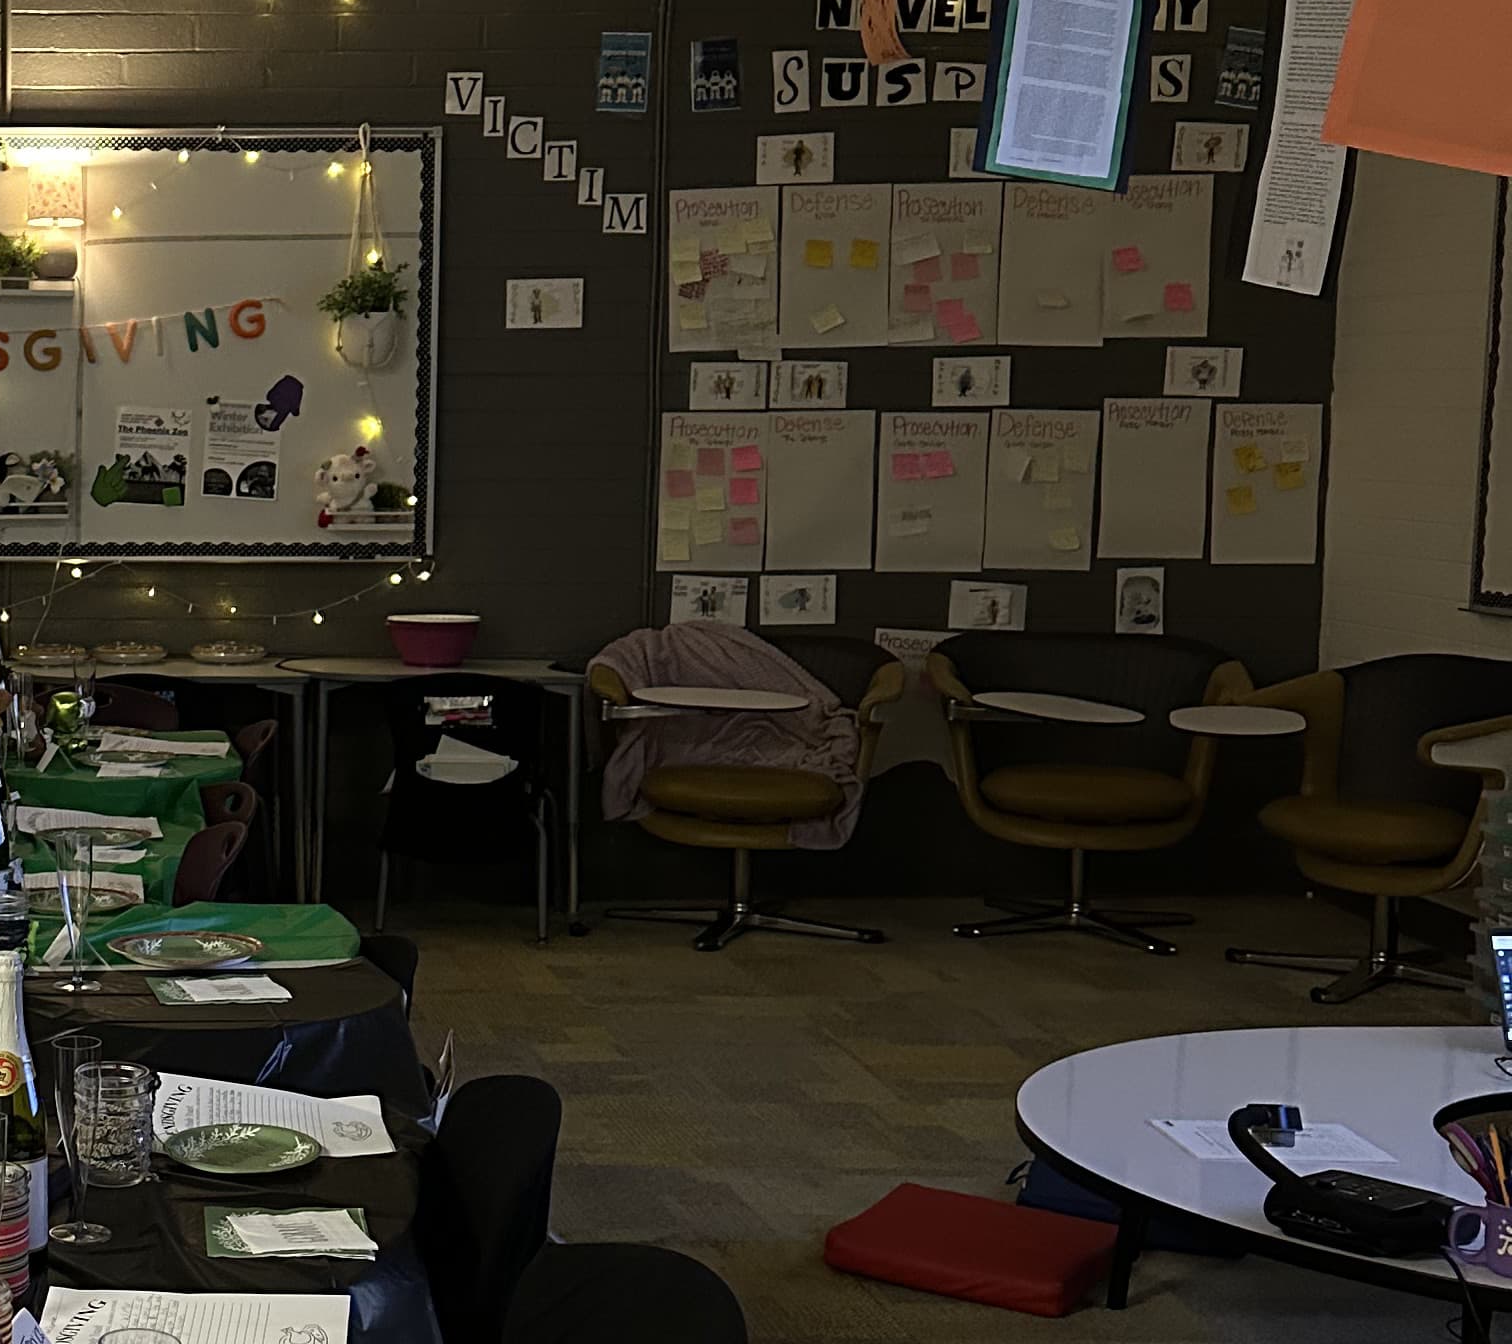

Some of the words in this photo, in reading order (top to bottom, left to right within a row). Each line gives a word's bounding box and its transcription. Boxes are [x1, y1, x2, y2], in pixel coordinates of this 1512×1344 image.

[777, 54, 1185, 106] SUSPS
[449, 77, 644, 231] VICTIM
[211, 411, 249, 423] Winter
